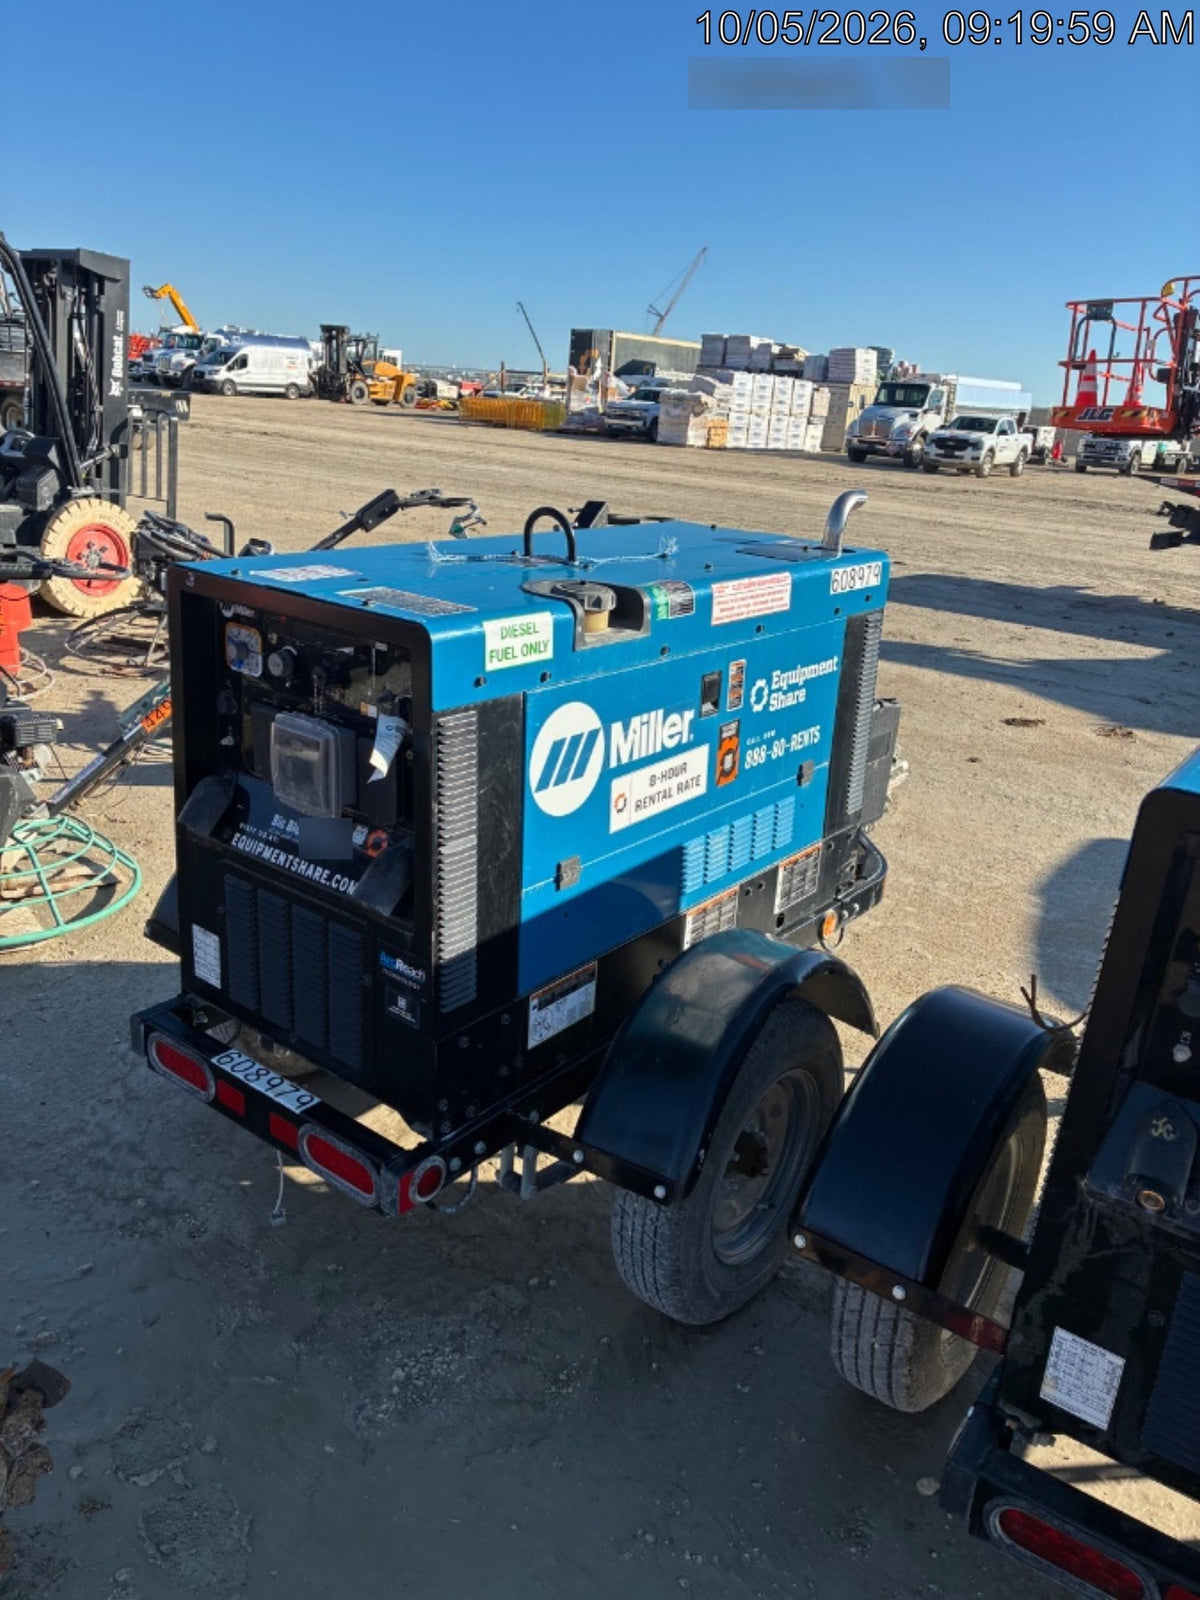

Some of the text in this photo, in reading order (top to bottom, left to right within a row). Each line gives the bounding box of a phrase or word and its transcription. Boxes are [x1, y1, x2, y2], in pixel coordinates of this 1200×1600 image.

[1076, 407, 1115, 423] JLG
[832, 563, 881, 593] 608979
[500, 621, 540, 640] DIESEL
[489, 639, 550, 663] FUEL ONLY
[771, 655, 839, 690] Equipment
[769, 688, 806, 711] Share
[609, 708, 697, 769] Miller
[745, 724, 821, 770] 888-80-RENTS
[649, 762, 688, 787] 8-HOUR
[634, 775, 701, 812] RENTAL RATE
[216, 1051, 315, 1110] 608979
